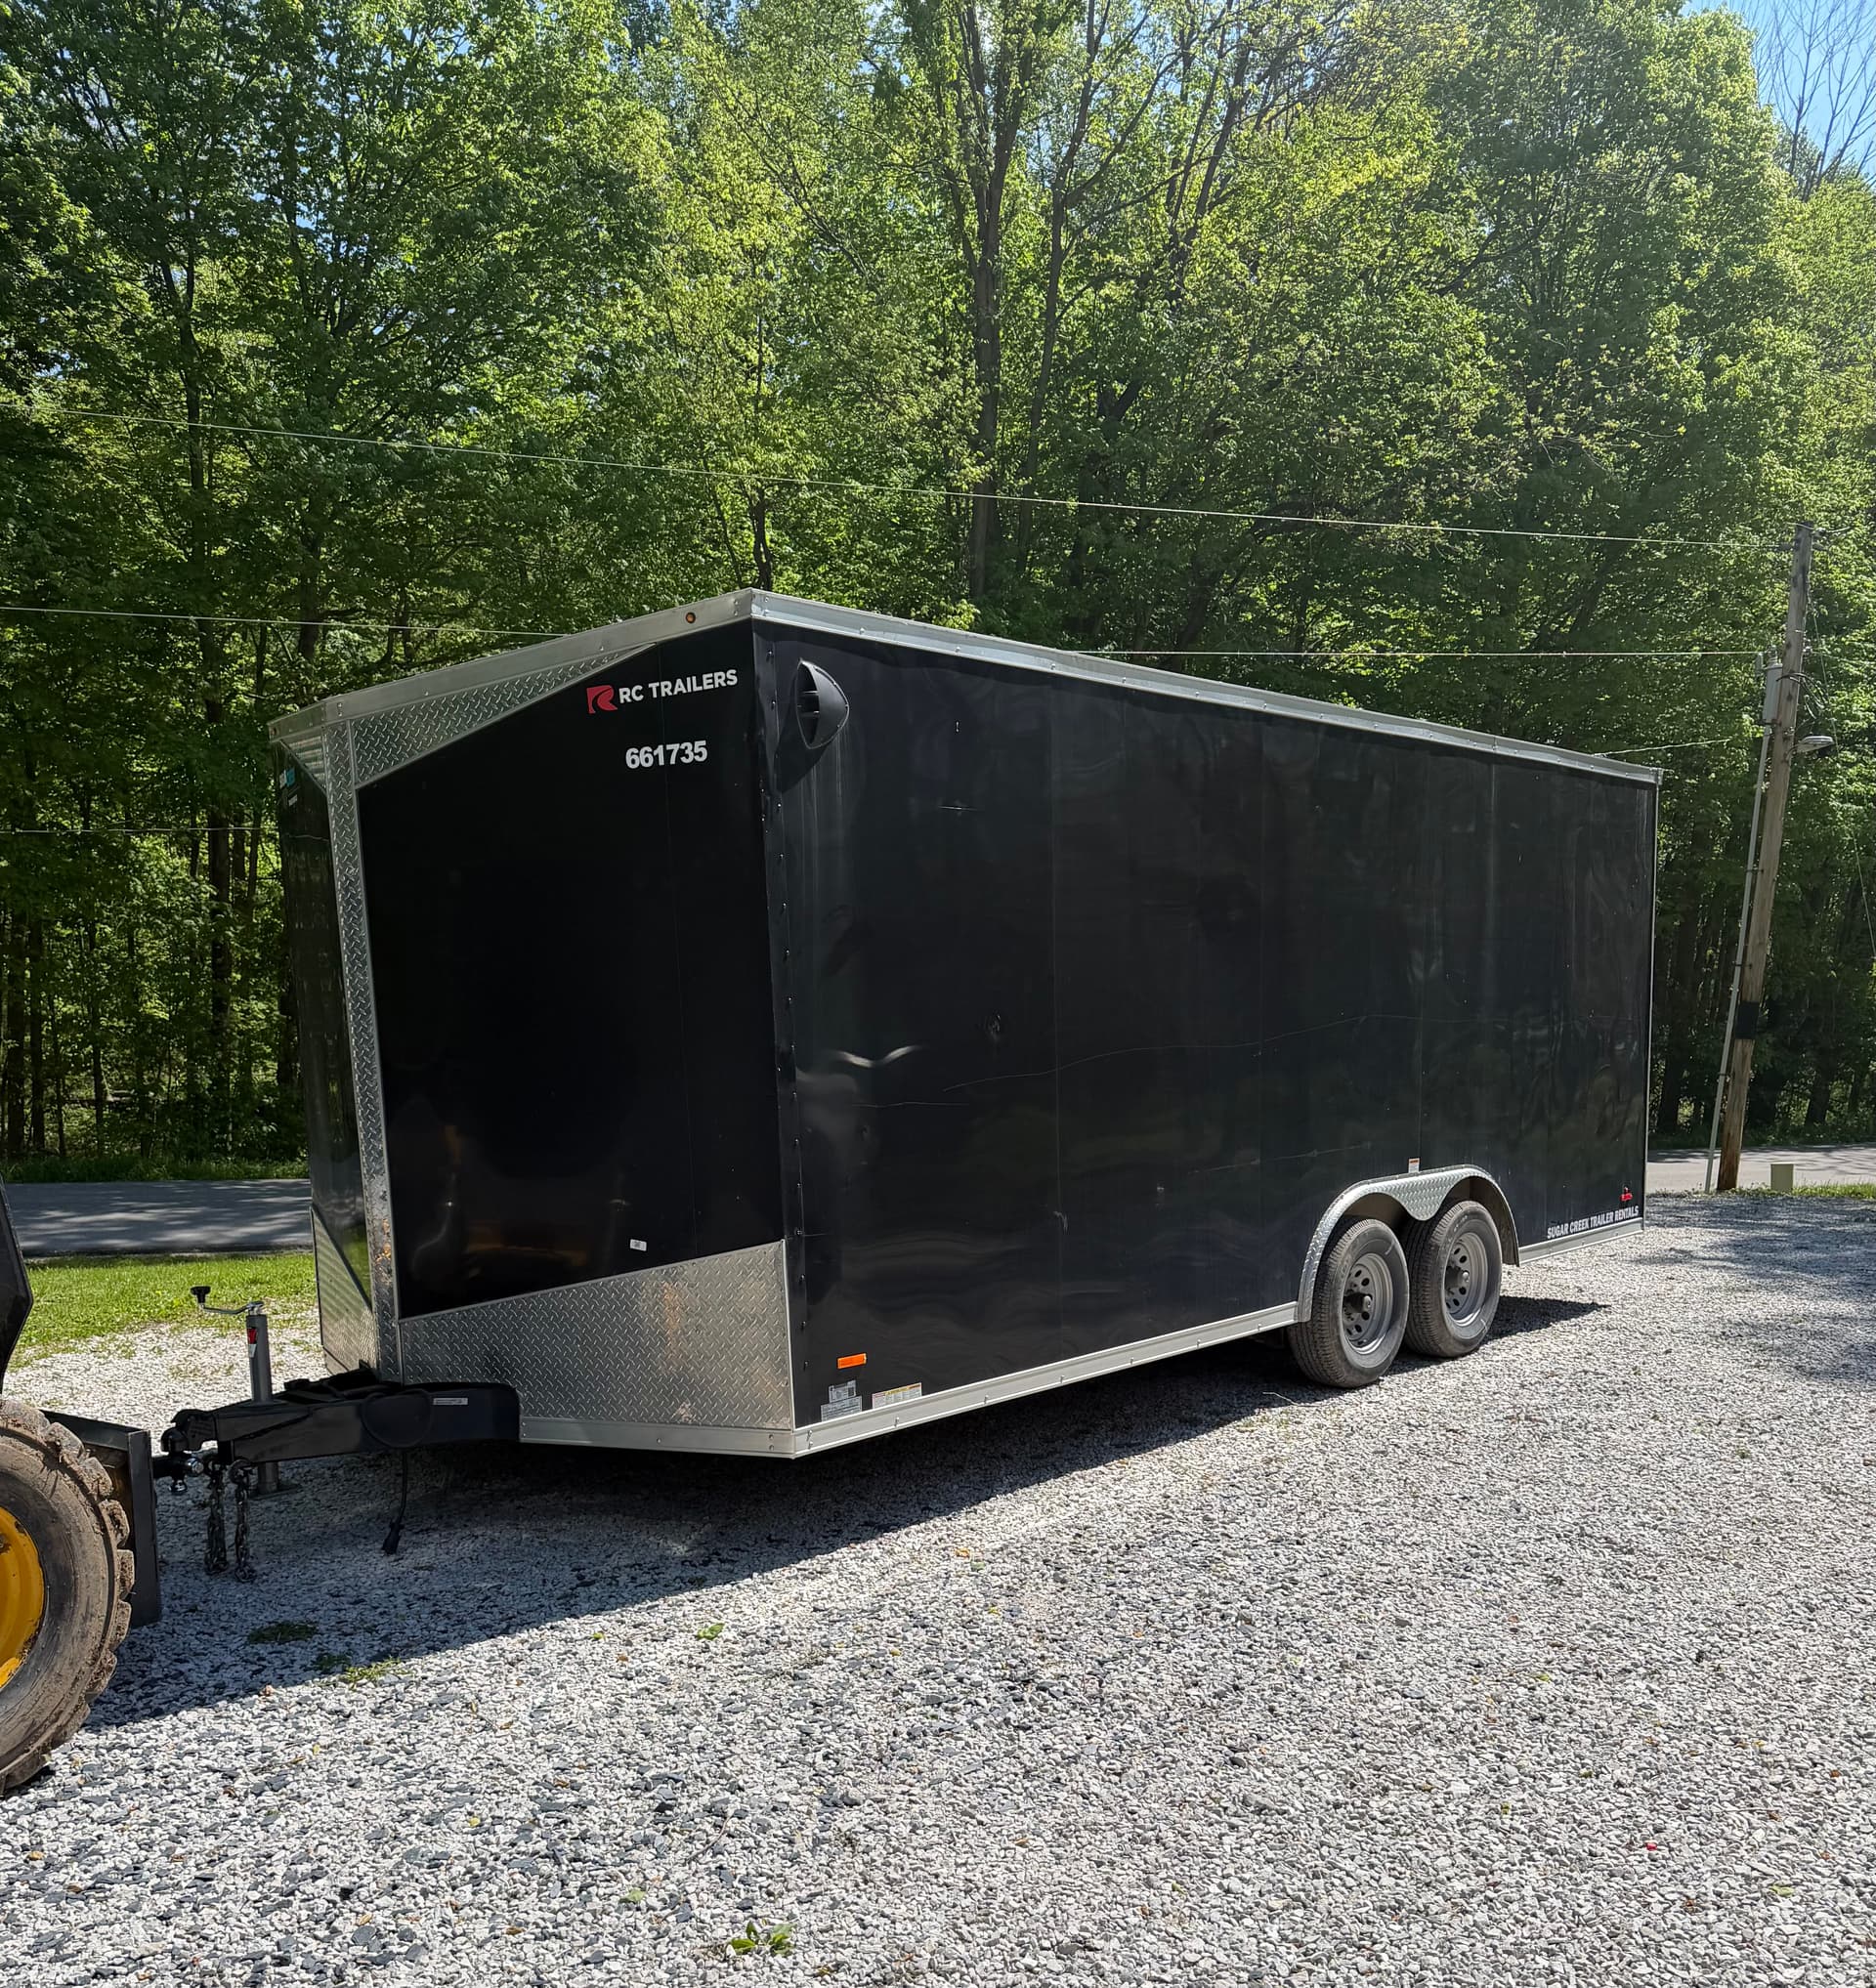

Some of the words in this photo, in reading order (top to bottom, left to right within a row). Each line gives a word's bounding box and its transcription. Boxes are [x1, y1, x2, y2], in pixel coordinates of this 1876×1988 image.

[618, 685, 644, 703] RC
[649, 669, 738, 698] TRAILERS
[625, 740, 707, 769] 661735
[1547, 1224, 1569, 1239] SUGAR
[1569, 1218, 1590, 1233] CREEK
[1590, 1211, 1614, 1227] TRAILER
[1614, 1205, 1639, 1221] RENTALS
